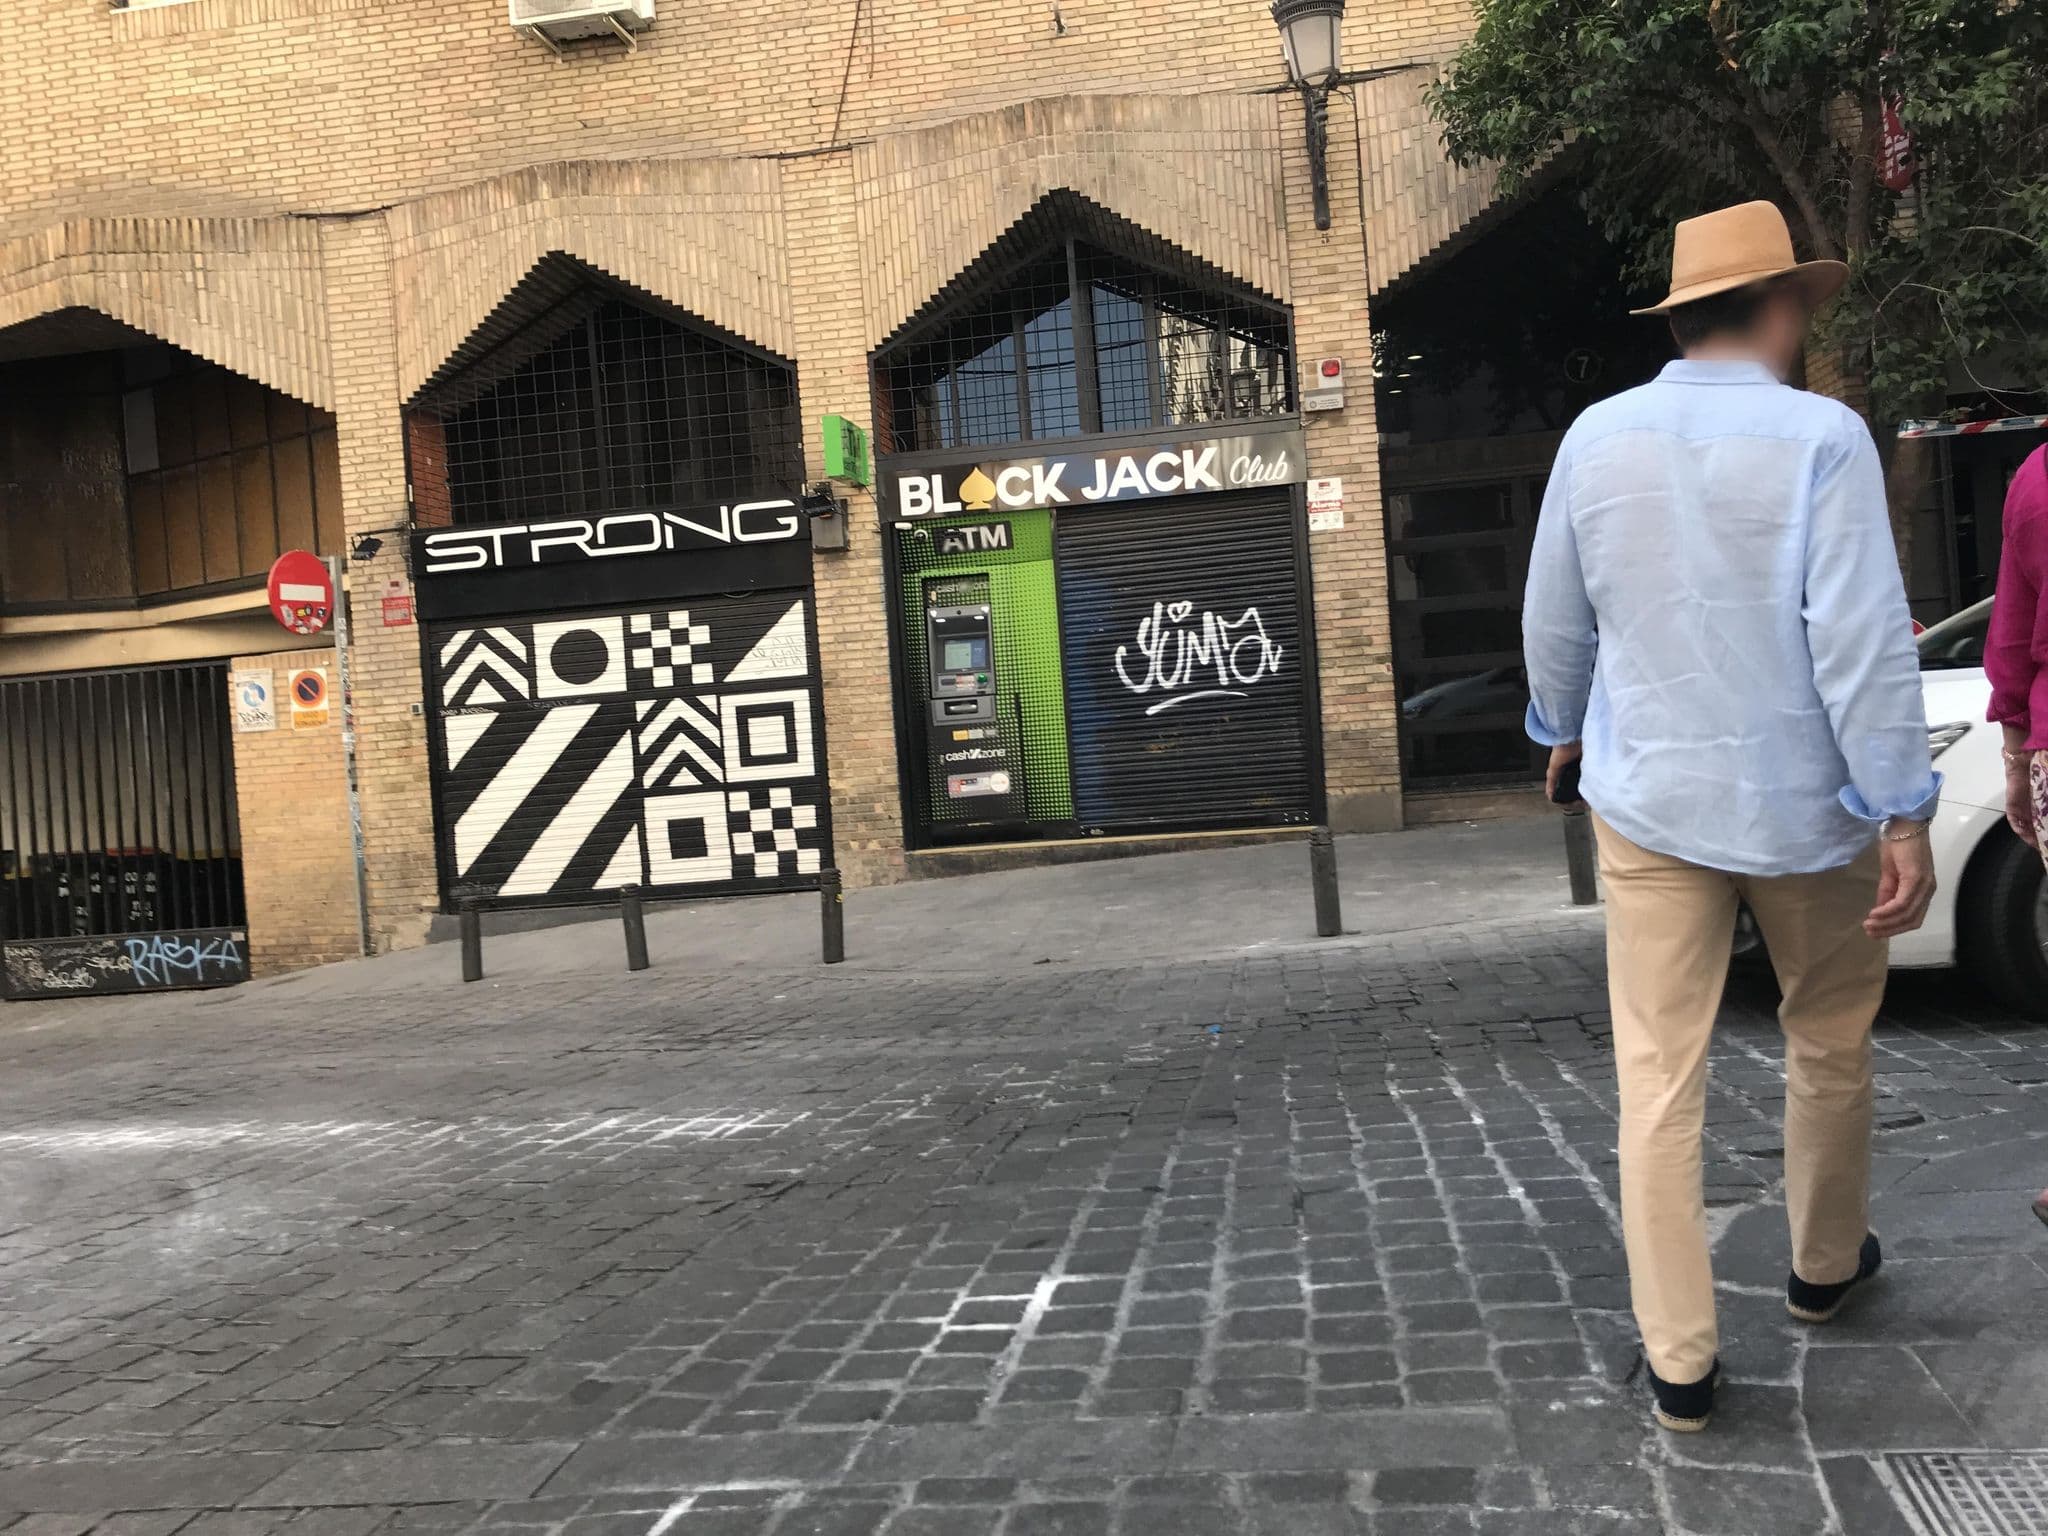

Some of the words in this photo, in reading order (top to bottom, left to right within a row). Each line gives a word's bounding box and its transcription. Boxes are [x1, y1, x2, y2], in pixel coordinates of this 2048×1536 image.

[1576, 355, 1590, 379] 7
[1081, 447, 1221, 501] JACK
[1229, 450, 1289, 485] Club
[425, 499, 799, 573] STRONG
[942, 523, 1008, 552] ATM
